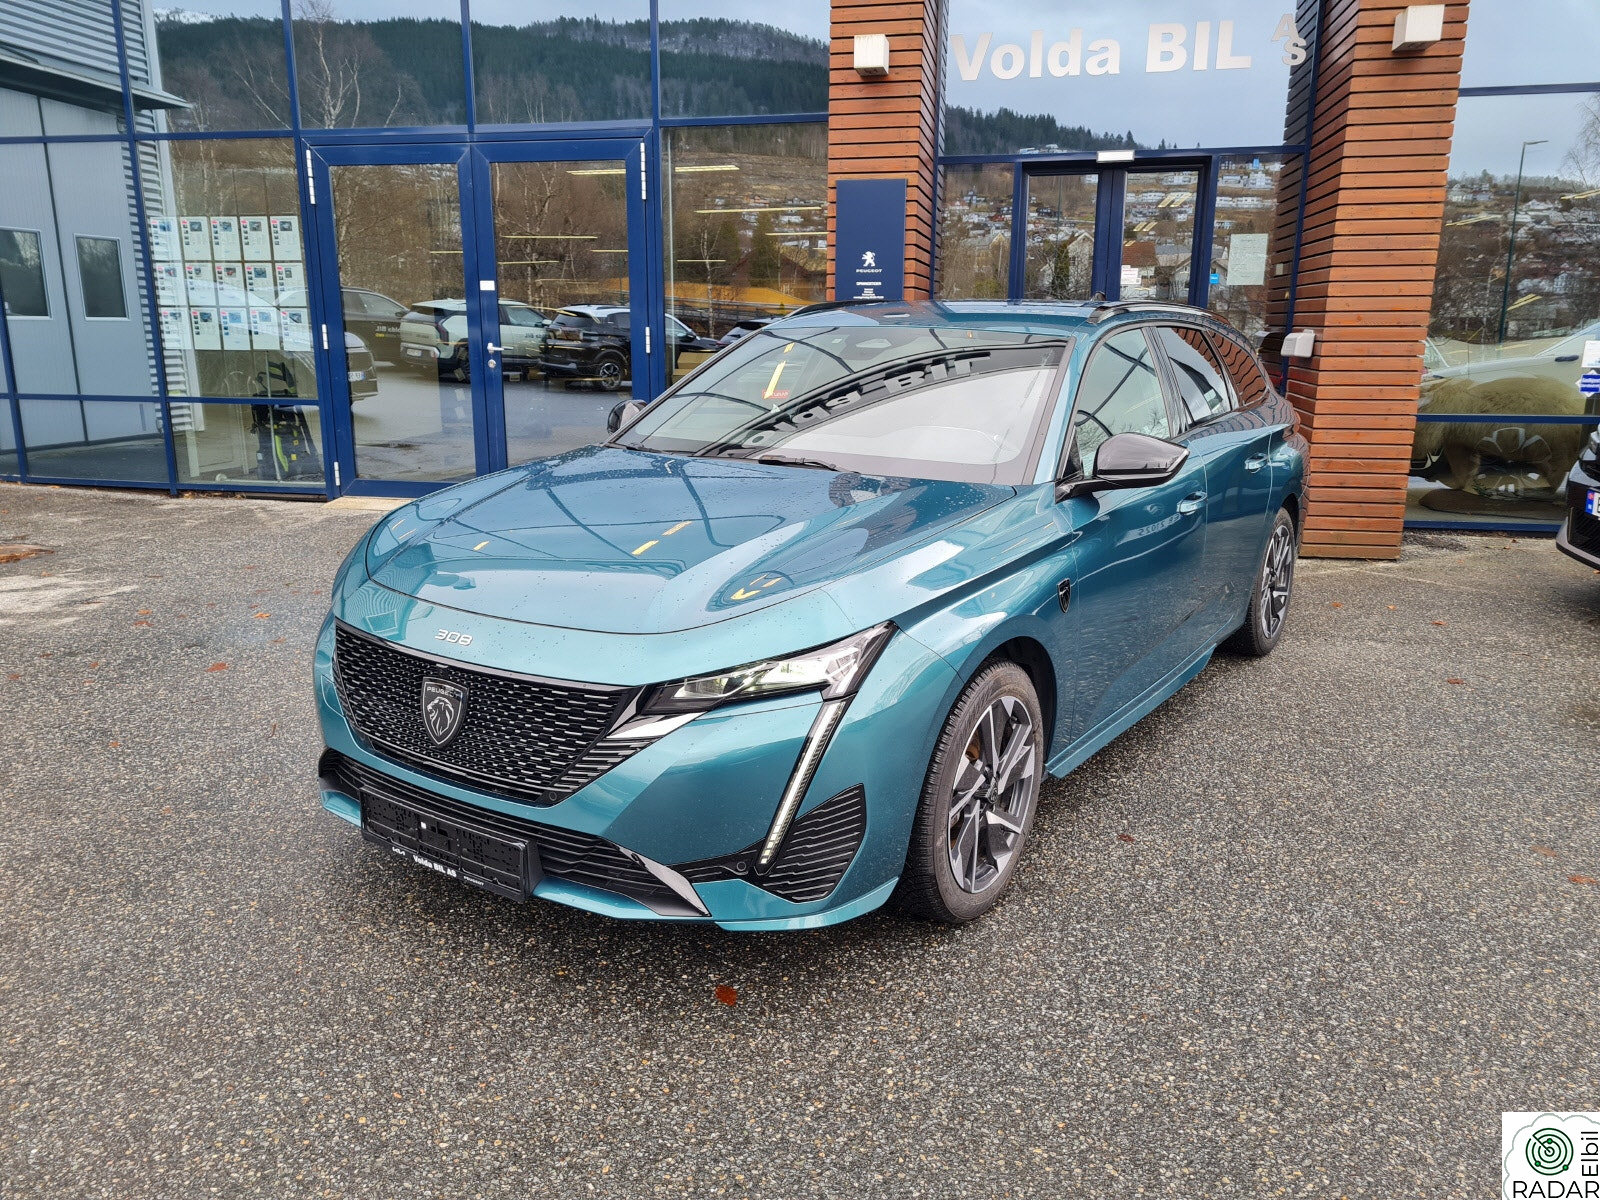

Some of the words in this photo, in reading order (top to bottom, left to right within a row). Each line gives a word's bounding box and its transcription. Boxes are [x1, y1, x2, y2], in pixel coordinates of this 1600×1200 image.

[950, 28, 1121, 81] Volda
[1146, 20, 1251, 73] BIL
[434, 629, 473, 646] 308
[412, 854, 433, 869] Volda
[433, 862, 447, 874] BIL
[447, 868, 457, 878] AS
